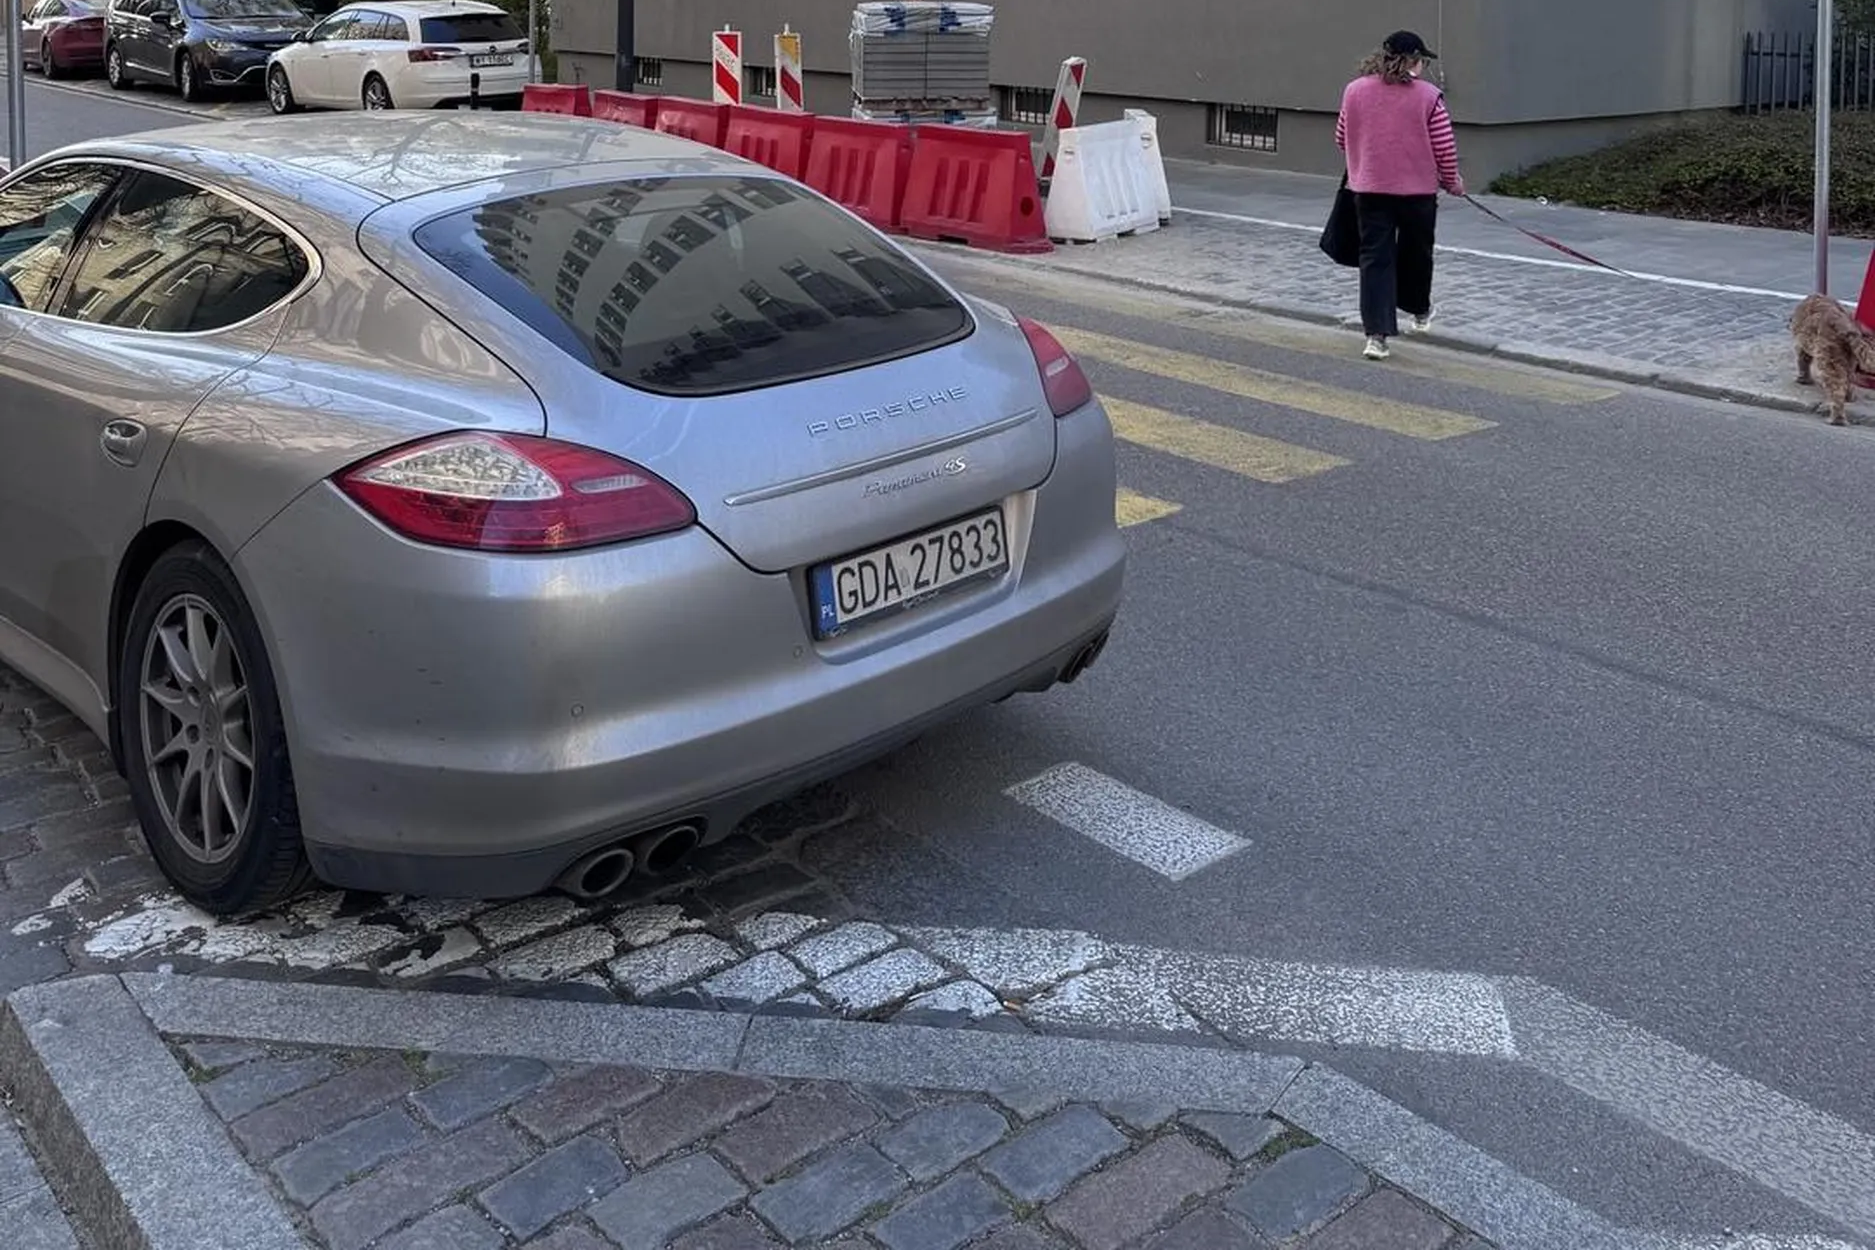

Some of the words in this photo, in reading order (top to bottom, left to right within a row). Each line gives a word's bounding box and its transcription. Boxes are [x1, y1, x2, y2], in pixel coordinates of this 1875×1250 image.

[806, 386, 968, 437] PORSCHE
[836, 552, 902, 615] GDA
[910, 518, 1001, 591] 27833
[821, 603, 835, 619] PL
